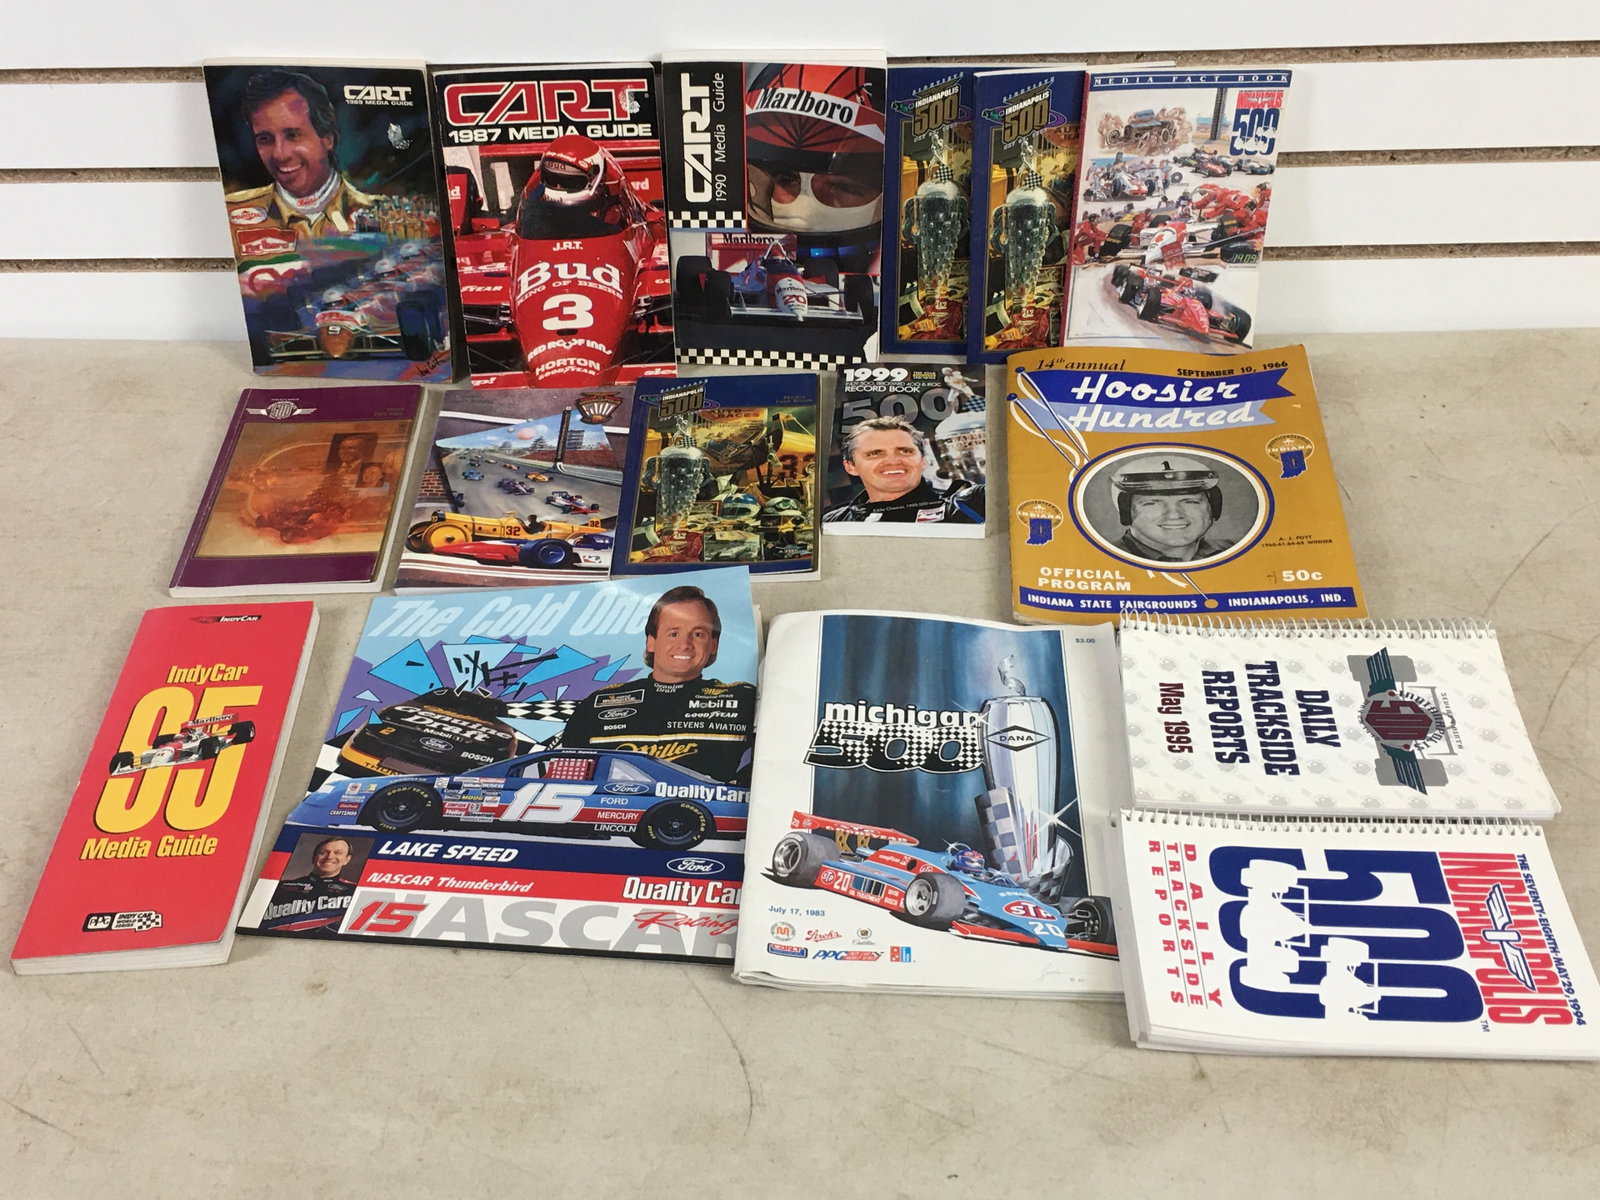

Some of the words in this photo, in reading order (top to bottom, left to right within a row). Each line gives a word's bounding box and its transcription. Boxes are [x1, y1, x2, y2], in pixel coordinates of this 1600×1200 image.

[1094, 76, 1154, 86] MEDIA
[1172, 75, 1221, 84] FACT
[1237, 73, 1289, 83] BOOK
[343, 85, 412, 101] CART
[443, 79, 648, 127] CART
[712, 72, 726, 113] Guide
[915, 86, 959, 108] INDIANAPOLIS
[1005, 90, 1050, 115] INDIANAPOLIS
[1236, 92, 1284, 109] INDIANAPOLIS
[756, 87, 854, 125] Marlboro
[914, 95, 959, 136] 500
[448, 128, 502, 143] 1987
[509, 126, 579, 140] MEDIA
[586, 124, 652, 138] GUIDE
[1003, 100, 1050, 143] 500
[1230, 108, 1281, 157] 500
[680, 73, 713, 203] CART
[713, 124, 727, 163] Media
[715, 174, 728, 202] 1990
[552, 240, 584, 252] J.R.T.
[516, 261, 624, 297] Bud
[516, 284, 546, 306] KING
[552, 279, 572, 288] OF
[577, 279, 624, 300] BEERS
[541, 293, 594, 331] 3
[535, 357, 600, 377] HORTON
[844, 367, 909, 382] 1999
[1036, 358, 1065, 370] 14th
[1064, 359, 1127, 371] annual
[1176, 368, 1235, 378] SEPTEMBER
[1240, 365, 1257, 374] 10,
[1262, 360, 1289, 370] 1966
[662, 387, 704, 401] INDIANAPOLIS
[889, 385, 921, 393] BOOK
[1070, 374, 1241, 403] Hoosier
[659, 393, 704, 418] 500
[1067, 401, 1255, 432] Hundred
[505, 525, 521, 536] 32
[1038, 577, 1131, 591] PROGRAM
[1039, 566, 1126, 580] OFFICIAL
[1027, 593, 1074, 608] INDIANA
[1080, 599, 1112, 609] STATE
[1119, 599, 1197, 610] FAIRGROUNDS
[1228, 595, 1314, 607] INDIANAPOLIS,
[1320, 593, 1346, 603] IND.
[367, 599, 465, 638] The
[459, 590, 581, 638] Cold
[1075, 637, 1096, 645] $3.00
[166, 663, 249, 685] IndyCar
[688, 699, 724, 709] Mobil
[1157, 682, 1186, 715] May
[394, 705, 513, 740] Genuine
[666, 720, 705, 729] STEVENS
[708, 721, 747, 732] AVIATION
[684, 710, 739, 720] GOODYEAR
[824, 700, 985, 729] michigan
[1201, 670, 1251, 765] REPORTS
[1244, 660, 1301, 776] TRACKSIDE
[1294, 689, 1342, 748] DAILY
[400, 713, 491, 742] Draft
[603, 723, 627, 731] BOSCH
[998, 734, 1034, 743] DANA
[1163, 720, 1194, 754] 1995
[460, 750, 495, 763] BOSCH
[803, 719, 986, 774] 500
[93, 686, 264, 834] 95
[611, 783, 642, 794] Ford
[655, 781, 714, 803] Quality
[499, 782, 599, 824] 15
[600, 796, 629, 806] FORD
[596, 811, 639, 821] MERCURY
[593, 824, 637, 833] LINCOLN
[80, 836, 152, 860] Media
[155, 834, 218, 858] Guide
[377, 840, 442, 858] LAKE
[442, 844, 519, 863] SPEED
[677, 858, 712, 873] Ford
[366, 872, 431, 886] NASCAR
[437, 876, 534, 893] Thunderbird
[622, 876, 703, 906] Quality
[833, 871, 852, 892] 20
[348, 900, 429, 934] 15
[768, 904, 787, 915] July
[790, 908, 802, 917] 17,
[805, 909, 826, 917] 1983
[1148, 839, 1185, 1004] REPORTS
[1028, 921, 1066, 938] 20
[1166, 842, 1204, 1006] TRACKSIDE
[1184, 843, 1224, 1008] DAILY
[1208, 845, 1485, 1024] 500
[1438, 851, 1574, 1026] INDIANAPOLIS
[1516, 853, 1530, 871] THE
[1568, 997, 1587, 1026] 1994
[1480, 1019, 1491, 1033] TM
